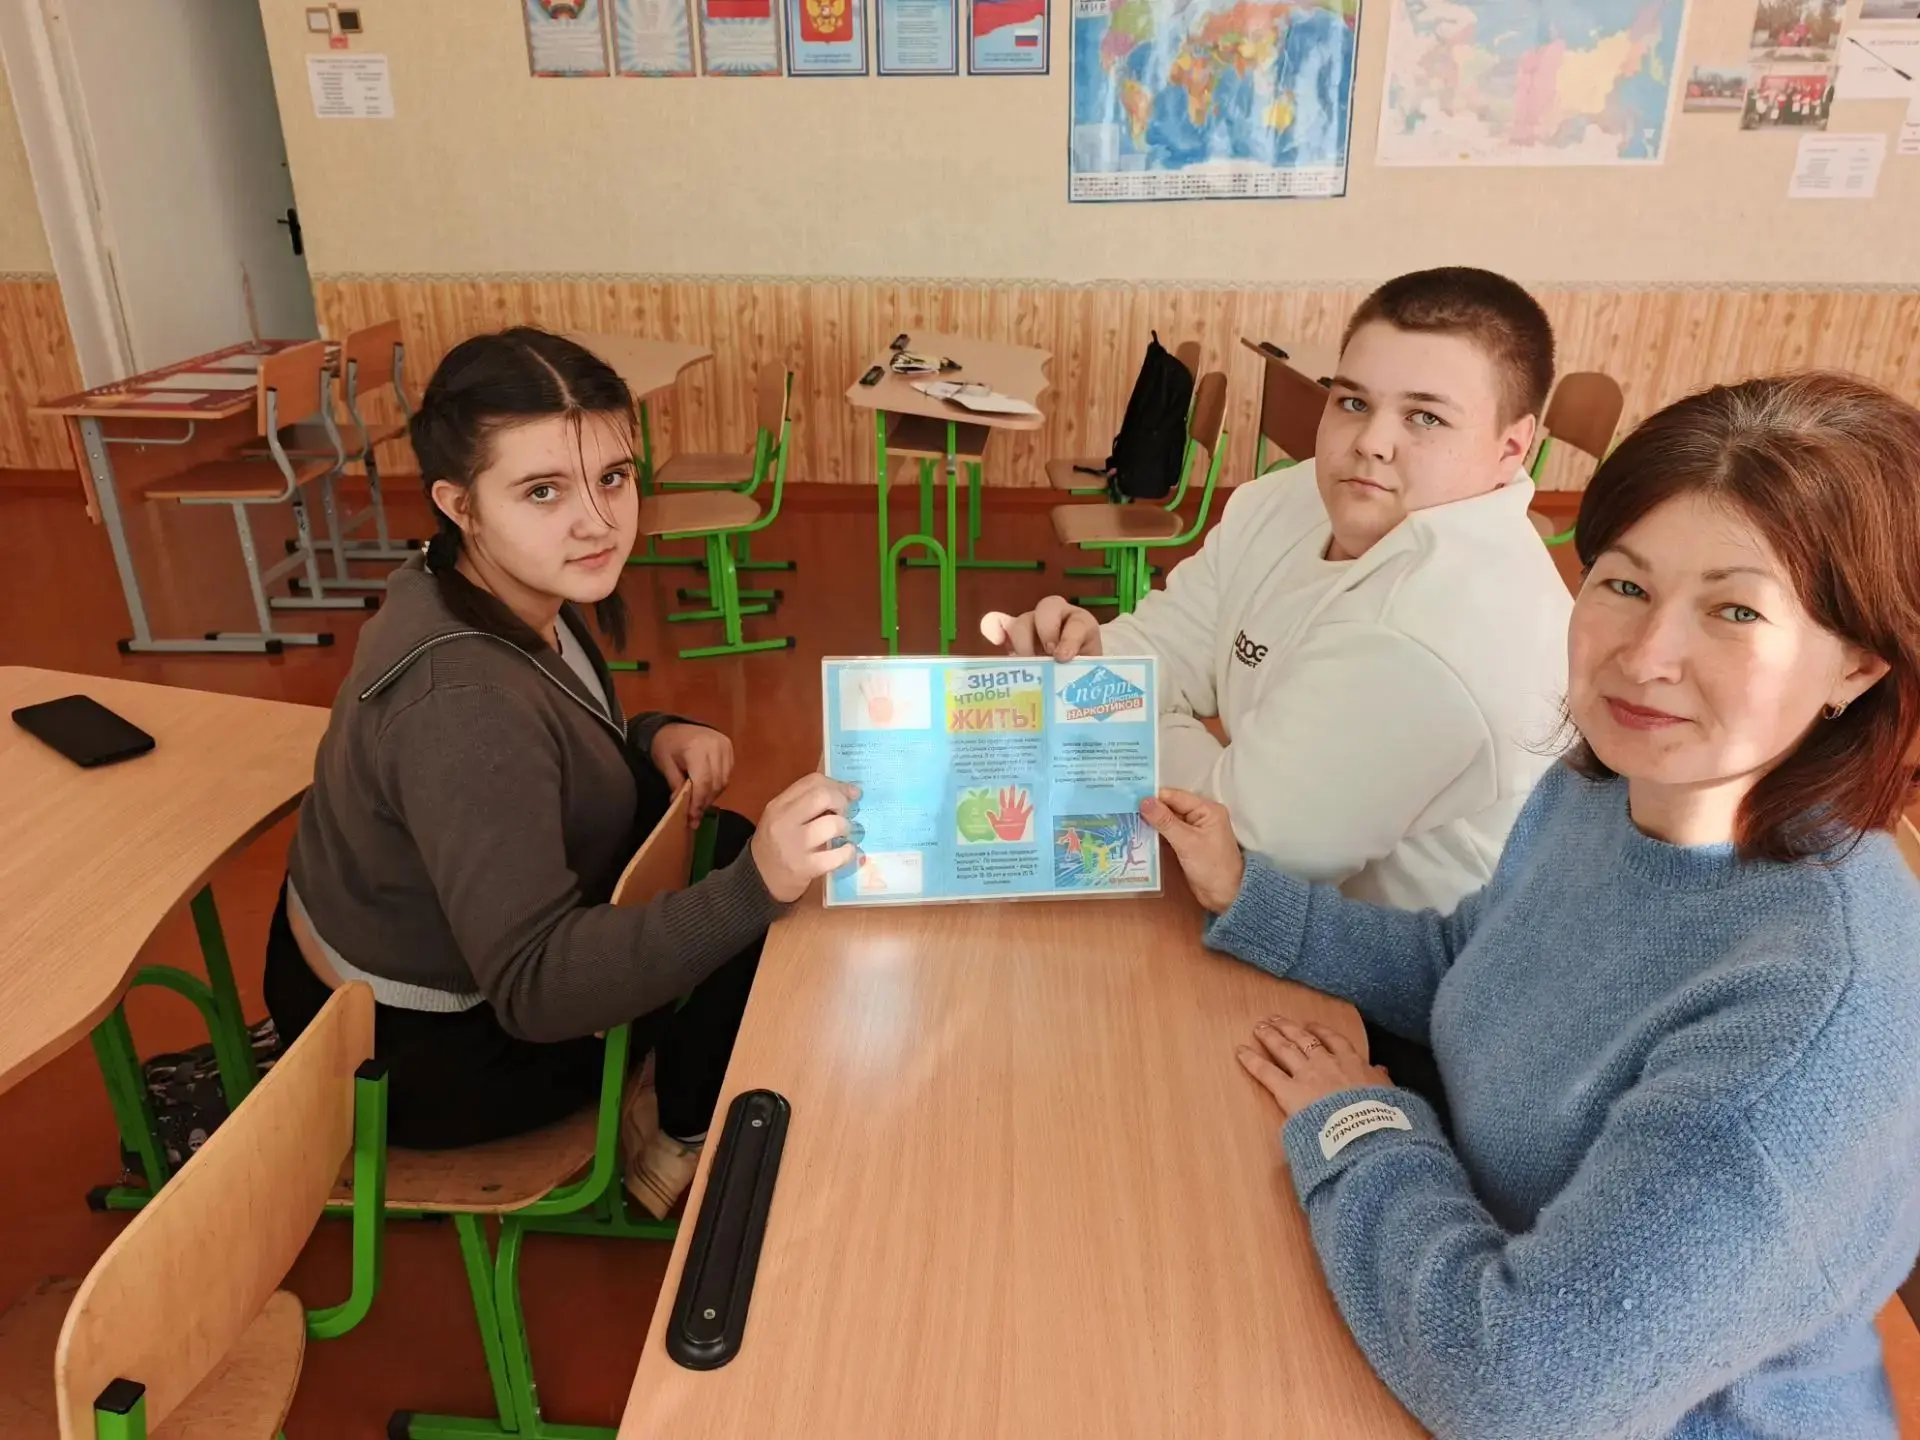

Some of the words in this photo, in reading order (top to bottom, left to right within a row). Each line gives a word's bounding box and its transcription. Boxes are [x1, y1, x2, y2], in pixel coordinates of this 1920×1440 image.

[968, 669, 1042, 689] знать,
[954, 686, 1010, 704] чтобы
[1062, 680, 1132, 704] Спорт
[950, 703, 1037, 730] ЖИТЬ!
[1067, 698, 1141, 720] НАРКОТИКОВ
